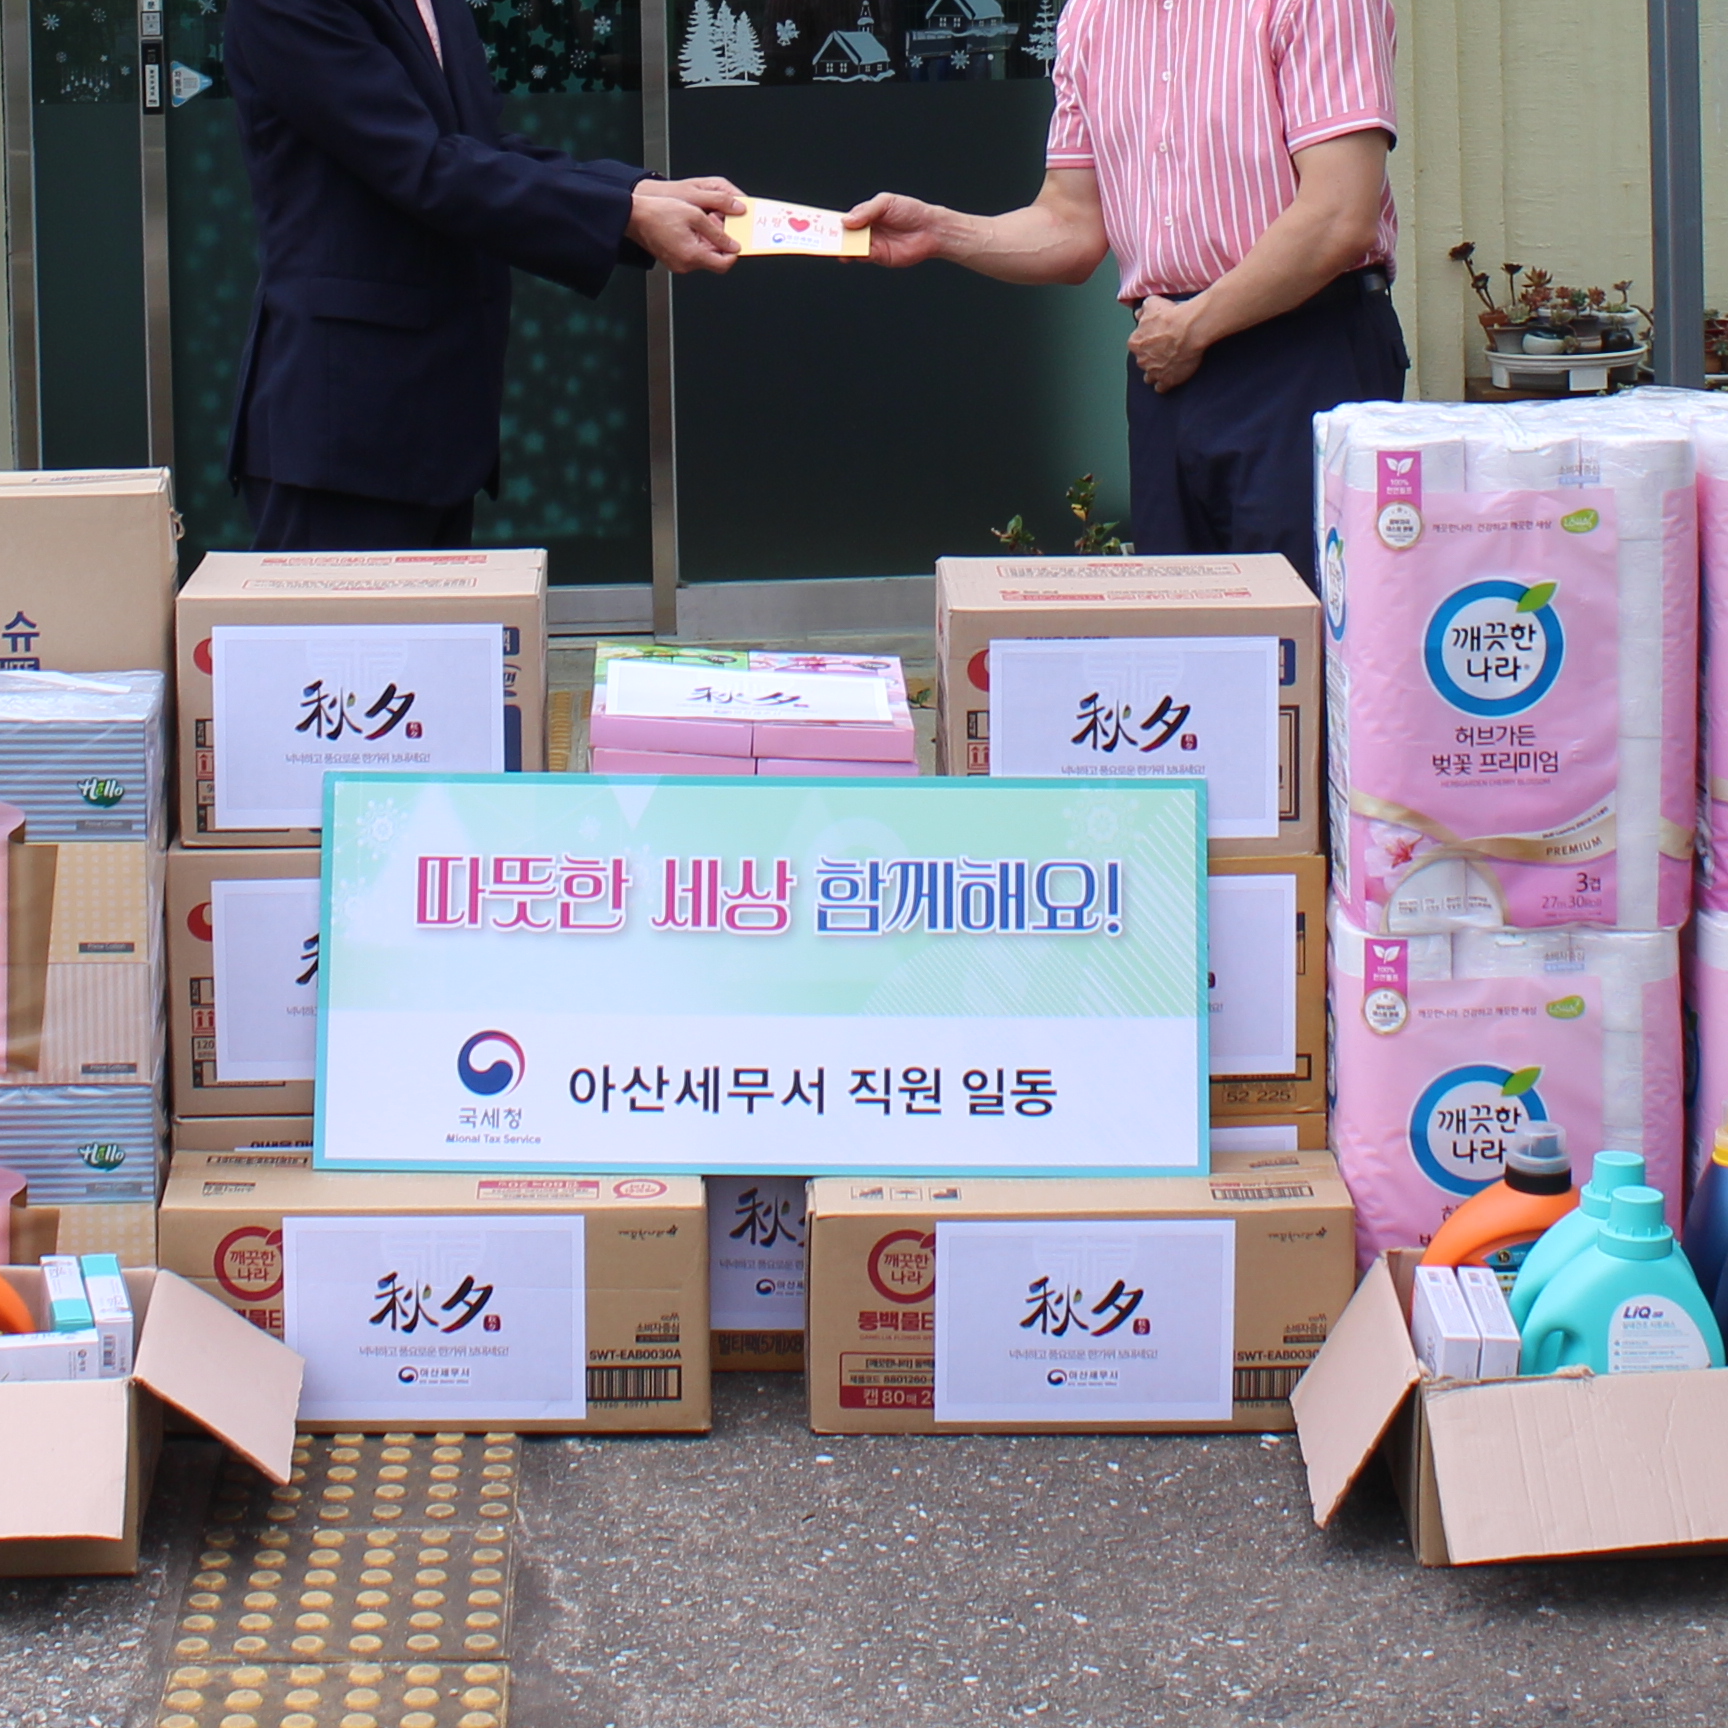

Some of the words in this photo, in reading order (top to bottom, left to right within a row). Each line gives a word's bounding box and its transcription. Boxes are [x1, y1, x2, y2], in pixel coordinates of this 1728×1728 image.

[1452, 622, 1536, 652] 깨끗한
[1467, 656, 1521, 683] 나라
[295, 679, 416, 741] 秋夕
[1071, 692, 1192, 753] 秋夕
[1454, 724, 1536, 748] 허브가든
[1432, 753, 1473, 776] 벚꽃
[1478, 751, 1559, 774] 프리미엄
[77, 777, 124, 801] Hello
[1545, 836, 1603, 857] PREMIUM
[416, 854, 630, 932] 따뜻한
[651, 855, 795, 932] 세상
[815, 855, 1123, 934] 함께해요!
[570, 1065, 826, 1115] 아산세무서
[848, 1065, 943, 1117] 직원
[962, 1065, 1058, 1118] 일동
[458, 1107, 522, 1130] 국세청
[1437, 1104, 1522, 1135] 깨끗한
[483, 1133, 502, 1144] Tax
[503, 1133, 542, 1145] Service
[1452, 1138, 1508, 1164] 나라
[79, 1142, 126, 1166] Hello
[729, 1186, 806, 1249] 秋
[230, 1250, 276, 1267] 깨끗한
[884, 1253, 931, 1270] 깨끗한
[237, 1267, 270, 1282] 나라
[890, 1270, 924, 1285] 나라
[368, 1271, 494, 1334] 秋夕
[1019, 1275, 1144, 1337] 秋夕
[1237, 1350, 1320, 1362] SWT-EAB003
[419, 1367, 470, 1378] 아산세무서
[883, 1373, 934, 1385] 8801260-
[1068, 1370, 1119, 1381] 아산세무서
[863, 1388, 879, 1406] 캡
